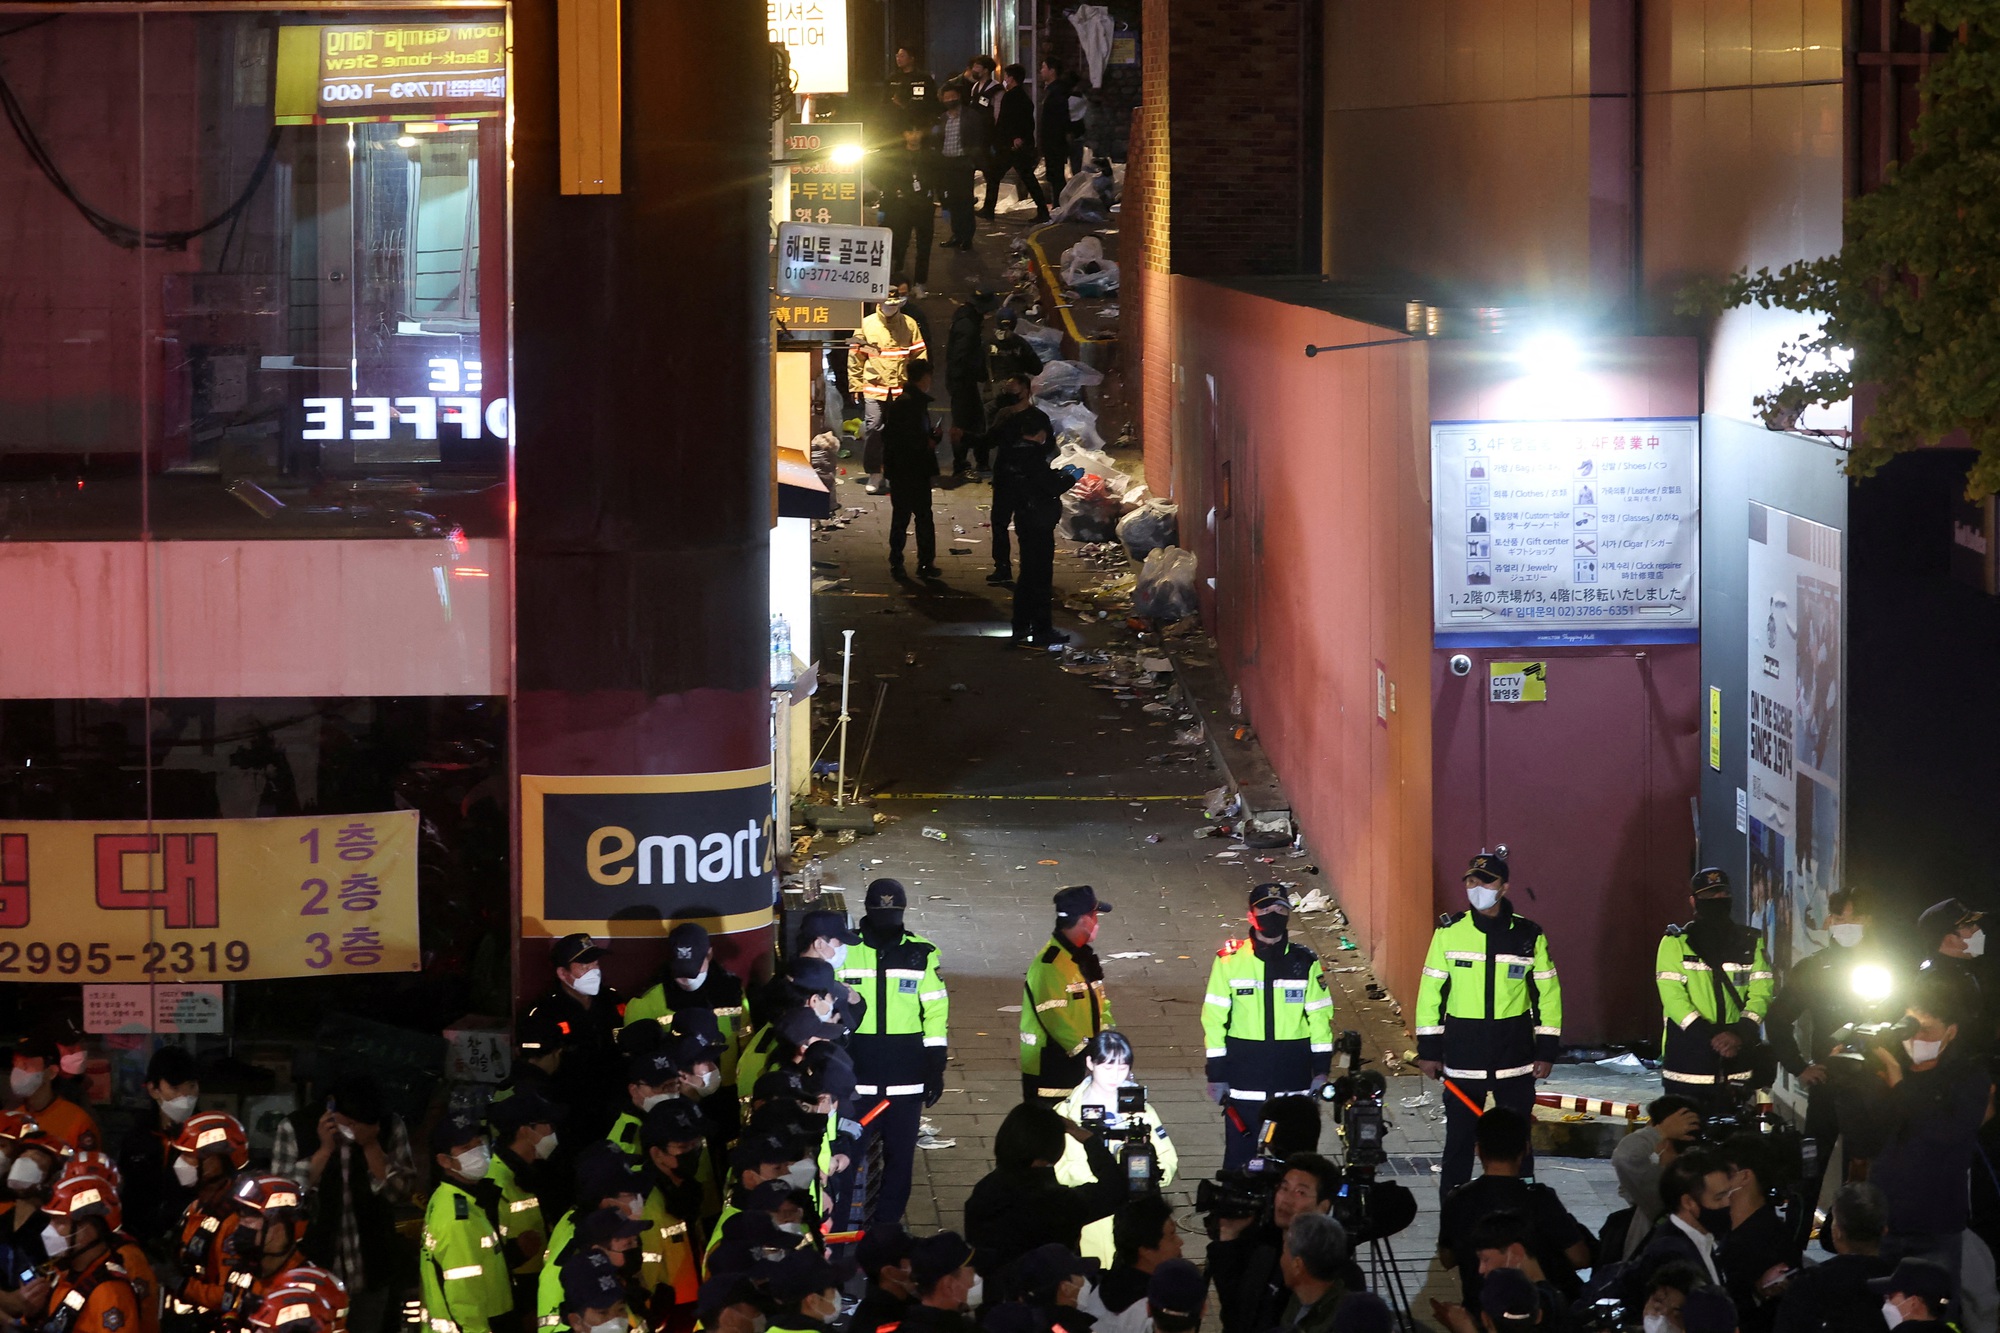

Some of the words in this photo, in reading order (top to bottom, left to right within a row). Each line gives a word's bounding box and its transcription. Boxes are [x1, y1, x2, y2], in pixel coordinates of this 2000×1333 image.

[786, 234, 832, 263] 해밀톤
[838, 238, 885, 268] 골프샵
[785, 266, 870, 284] 010-3772-4268
[871, 283, 884, 294] B1
[1487, 437, 1505, 450] 4F
[1623, 462, 1646, 470] Shoes
[1493, 490, 1508, 499] 의류
[1515, 489, 1544, 498] Clothes
[1525, 511, 1570, 519] Custom-tailor
[1601, 514, 1615, 522] 안경
[1622, 514, 1650, 522] Glasses
[1508, 521, 1559, 530] オーダーメード
[1526, 537, 1541, 546] Gift
[1543, 537, 1569, 546] center
[1601, 540, 1616, 548] 시가
[1623, 540, 1643, 549] Cigar
[1651, 539, 1673, 547] シガー
[1508, 547, 1556, 556] ギフトショップ
[1495, 563, 1519, 573] 쥬얼리
[1526, 563, 1558, 573] Jewelry
[1636, 561, 1654, 570] Clock
[1656, 561, 1682, 570] repairer
[1511, 573, 1547, 582] ジュエリー
[1500, 607, 1513, 617] 4F
[1516, 606, 1555, 618] 임대문의
[1557, 605, 1634, 617] 02)3786-6351
[1493, 677, 1520, 687] CCTV
[1493, 689, 1520, 700] 촬영중
[1761, 694, 1772, 729] THE
[1751, 722, 1772, 769] SINCE
[1774, 734, 1792, 781] 1974
[300, 822, 379, 864] 1층
[0, 833, 219, 929] 대
[300, 873, 382, 916] 2층
[305, 926, 384, 970] 3층
